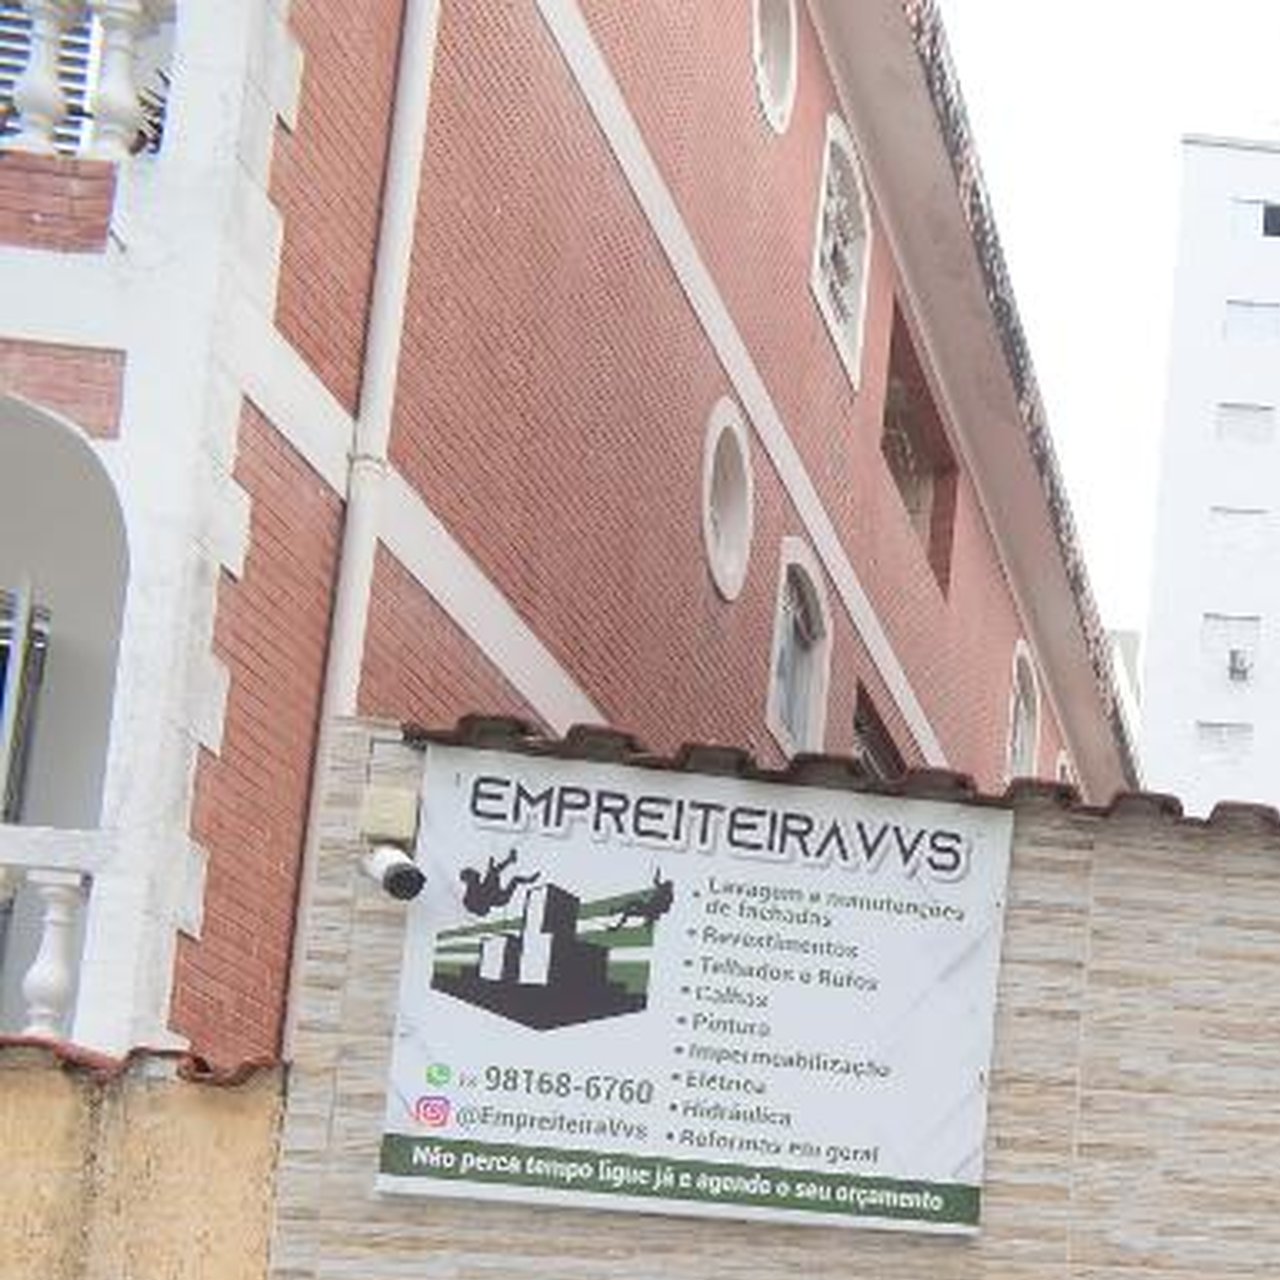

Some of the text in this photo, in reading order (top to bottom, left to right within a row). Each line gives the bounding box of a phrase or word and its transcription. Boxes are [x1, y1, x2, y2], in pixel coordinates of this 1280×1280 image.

[705, 901, 833, 927] de fachadas
[708, 877, 965, 922] Lavagem e manutenções
[702, 925, 860, 958] Revestimentos
[699, 956, 879, 992] Telhados e Rufos
[695, 985, 769, 1008] Calhas
[692, 1012, 771, 1038] Pintura
[688, 1043, 892, 1080] Impermeabilização
[484, 1065, 654, 1105] 98168-6760
[686, 1071, 767, 1095] Elétrica
[682, 1101, 792, 1127] Hidráulica
[679, 1128, 880, 1164] Reformas em geral
[411, 1145, 944, 1211] Não perca tempo ligue já e agende o seu orçamento
